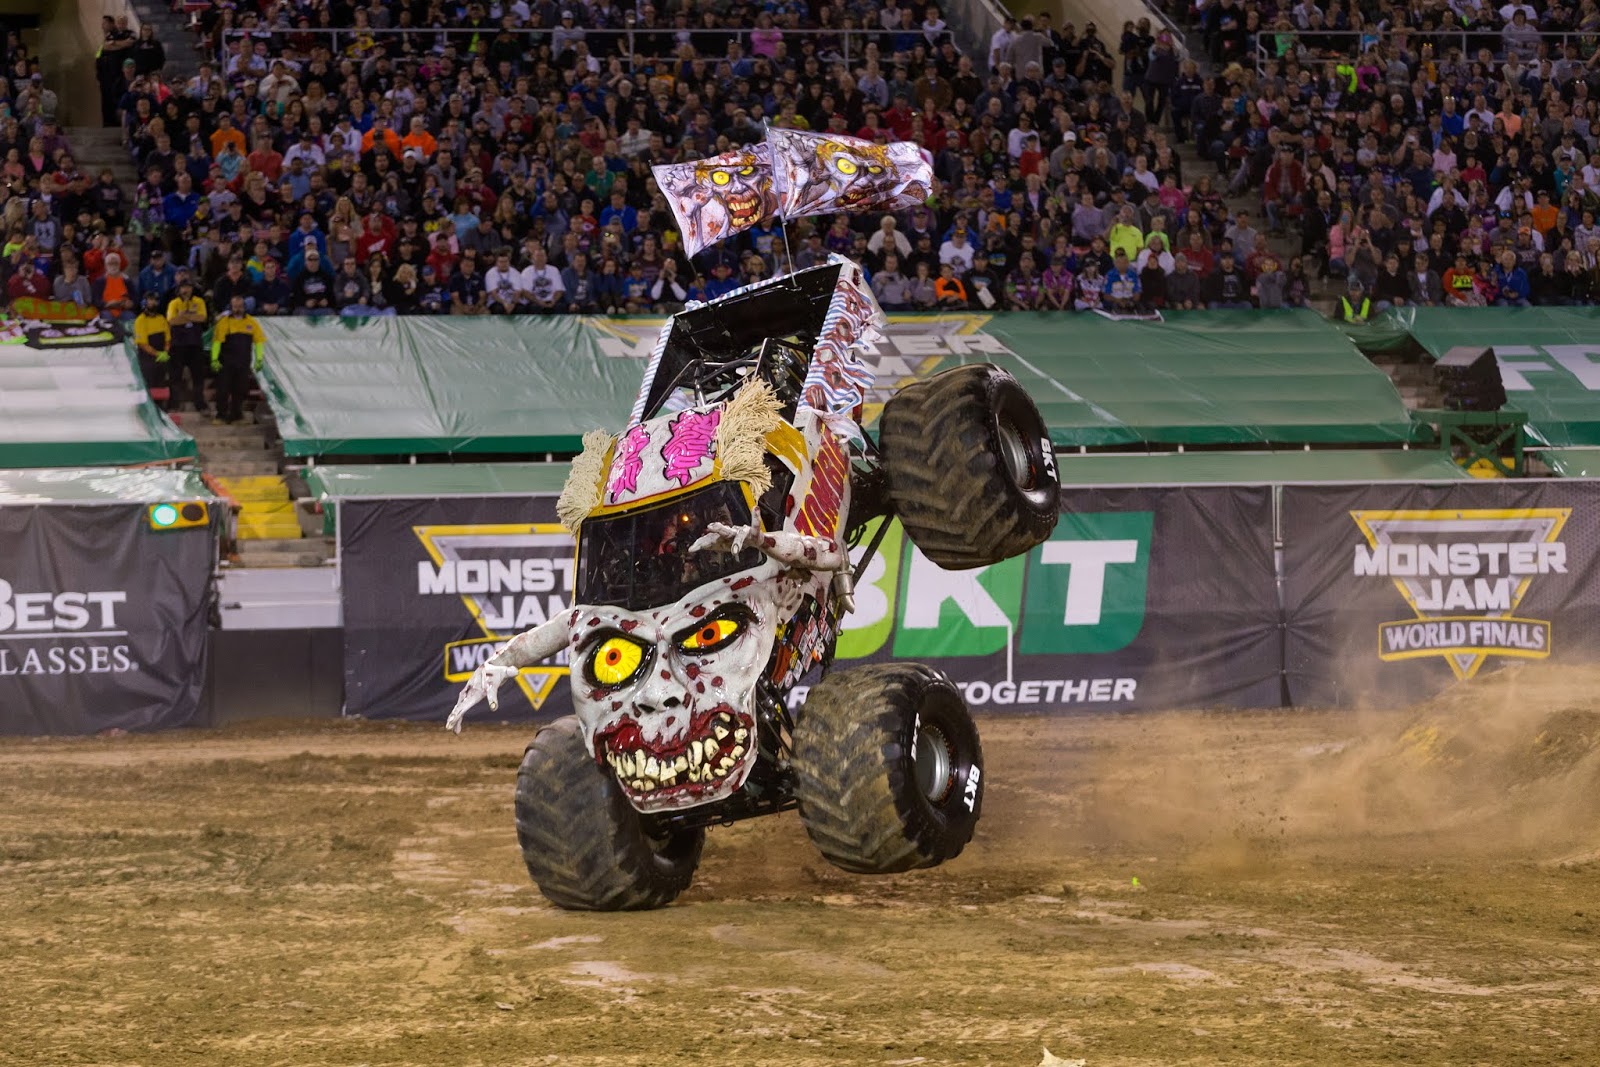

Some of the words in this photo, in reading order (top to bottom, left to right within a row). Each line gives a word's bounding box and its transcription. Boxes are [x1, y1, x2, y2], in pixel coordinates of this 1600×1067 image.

[1041, 437, 1057, 482] BKT
[418, 558, 575, 594] MONST
[1353, 542, 1568, 576] MONSTER
[1415, 577, 1511, 611] JAM
[1385, 621, 1466, 651] WORLD
[1470, 621, 1544, 650] FINALS
[963, 764, 980, 814] BKT
